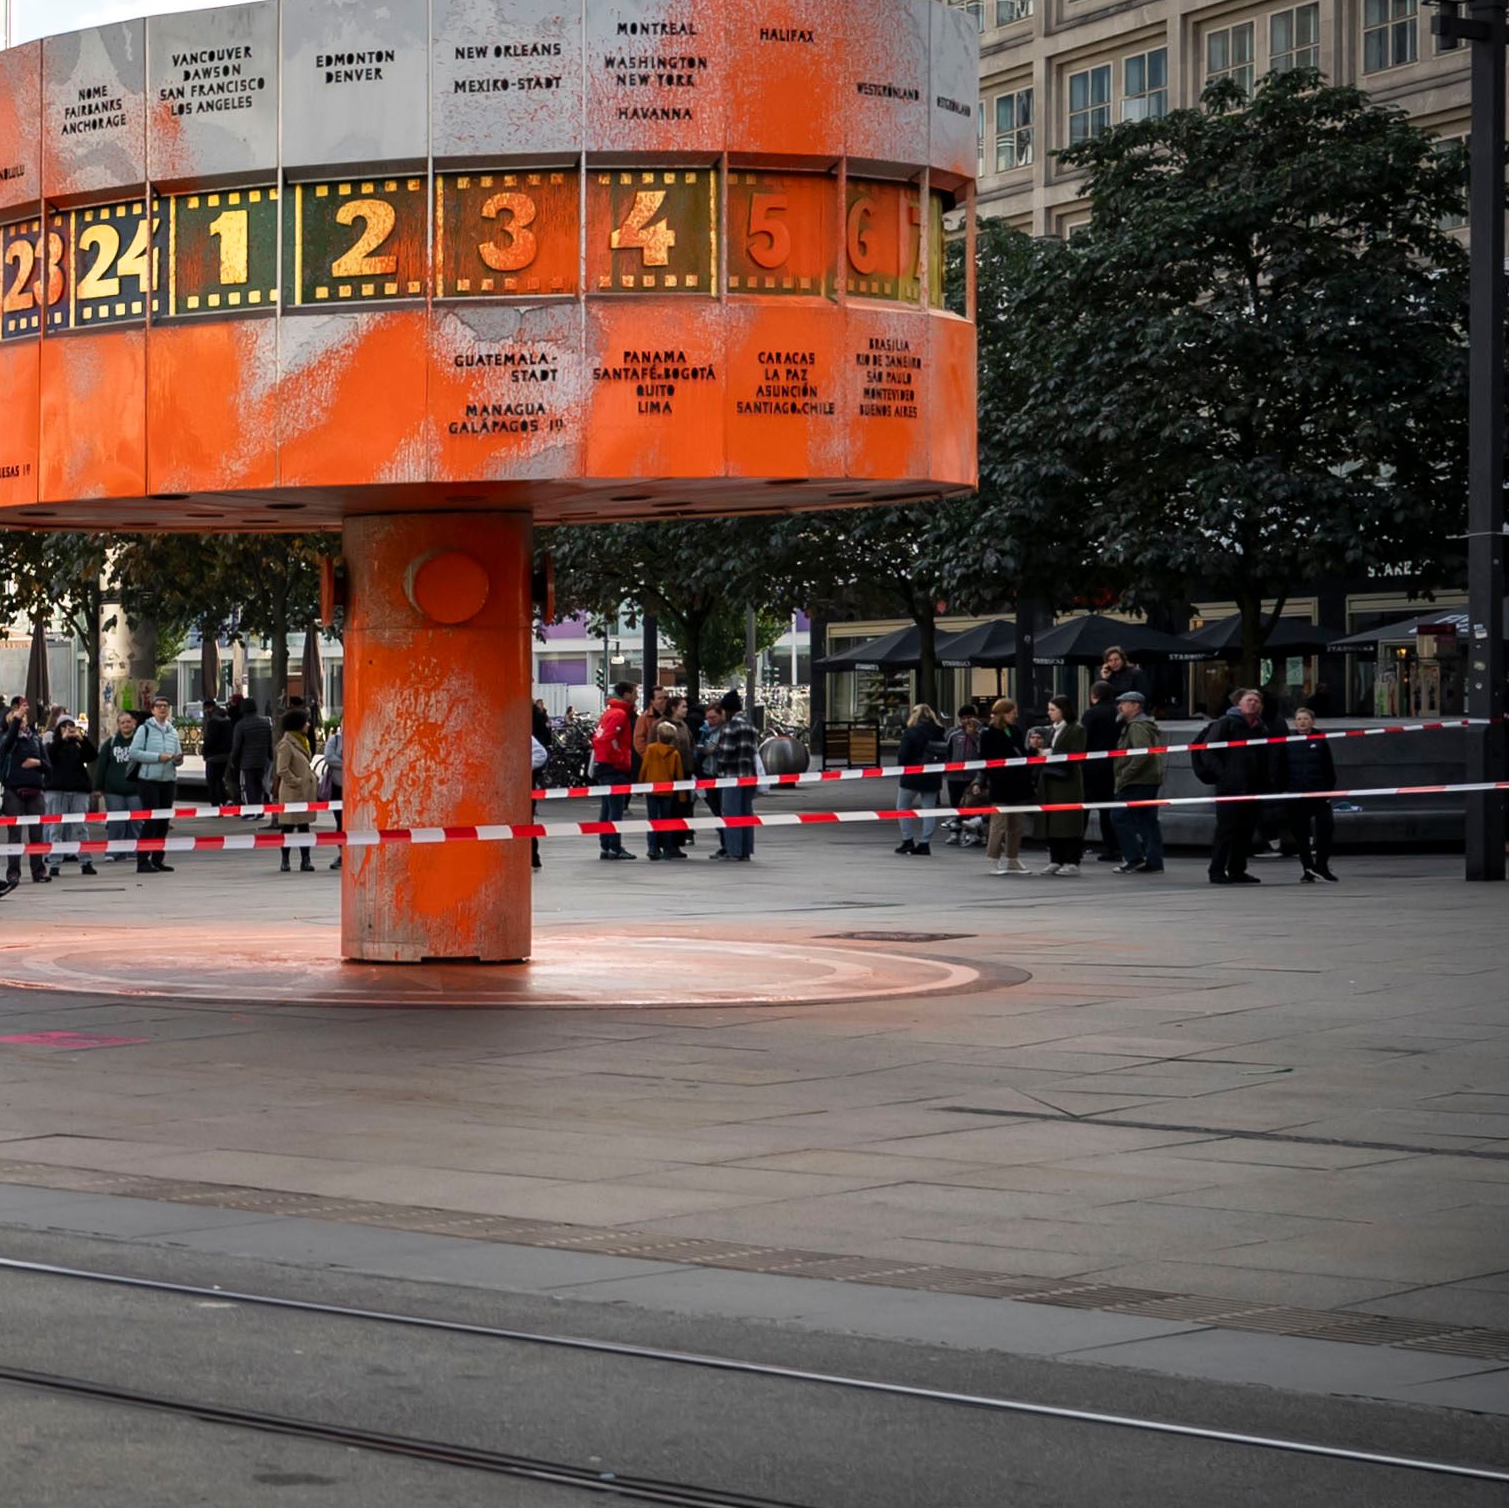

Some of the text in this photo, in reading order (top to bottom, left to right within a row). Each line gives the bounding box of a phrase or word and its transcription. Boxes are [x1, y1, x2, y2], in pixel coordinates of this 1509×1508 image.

[617, 22, 698, 36] MONTREAL
[760, 28, 814, 42] HALIFAX
[172, 45, 253, 67] VANCOUVER
[316, 49, 395, 68] EDMONTON
[455, 43, 562, 60] NEW ORLEANS
[604, 56, 708, 70] WASHINGTON
[183, 64, 241, 82] DAWSON
[325, 67, 383, 84] DENVER
[616, 73, 695, 87] NEW YORK
[160, 77, 265, 101] SAN FRANCISCO
[454, 76, 562, 93] MEXIKO-STADT
[78, 85, 108, 102] NOME
[65, 98, 122, 120] FAIRBANKS
[171, 95, 253, 116] LOS ANGELES
[618, 107, 693, 121] HAVANNA
[61, 114, 127, 135] ANCHORAGE
[478, 193, 537, 271] 3
[611, 191, 676, 267] 4
[748, 193, 791, 269] 5
[847, 197, 879, 274] 6
[332, 199, 397, 278] 2
[209, 210, 249, 285] 1
[77, 218, 161, 300] 24
[4, 232, 64, 313] 23
[454, 352, 557, 367] GUATEMALA-
[623, 351, 686, 363] PANAMA
[758, 351, 815, 365] CARACAS
[511, 369, 558, 383] STADT
[765, 368, 808, 381] LA PAZ
[636, 384, 675, 396] QUITO
[466, 403, 546, 417] MANAGUA
[638, 401, 672, 413] LIMA
[449, 417, 539, 434] GALÁPAGOS
